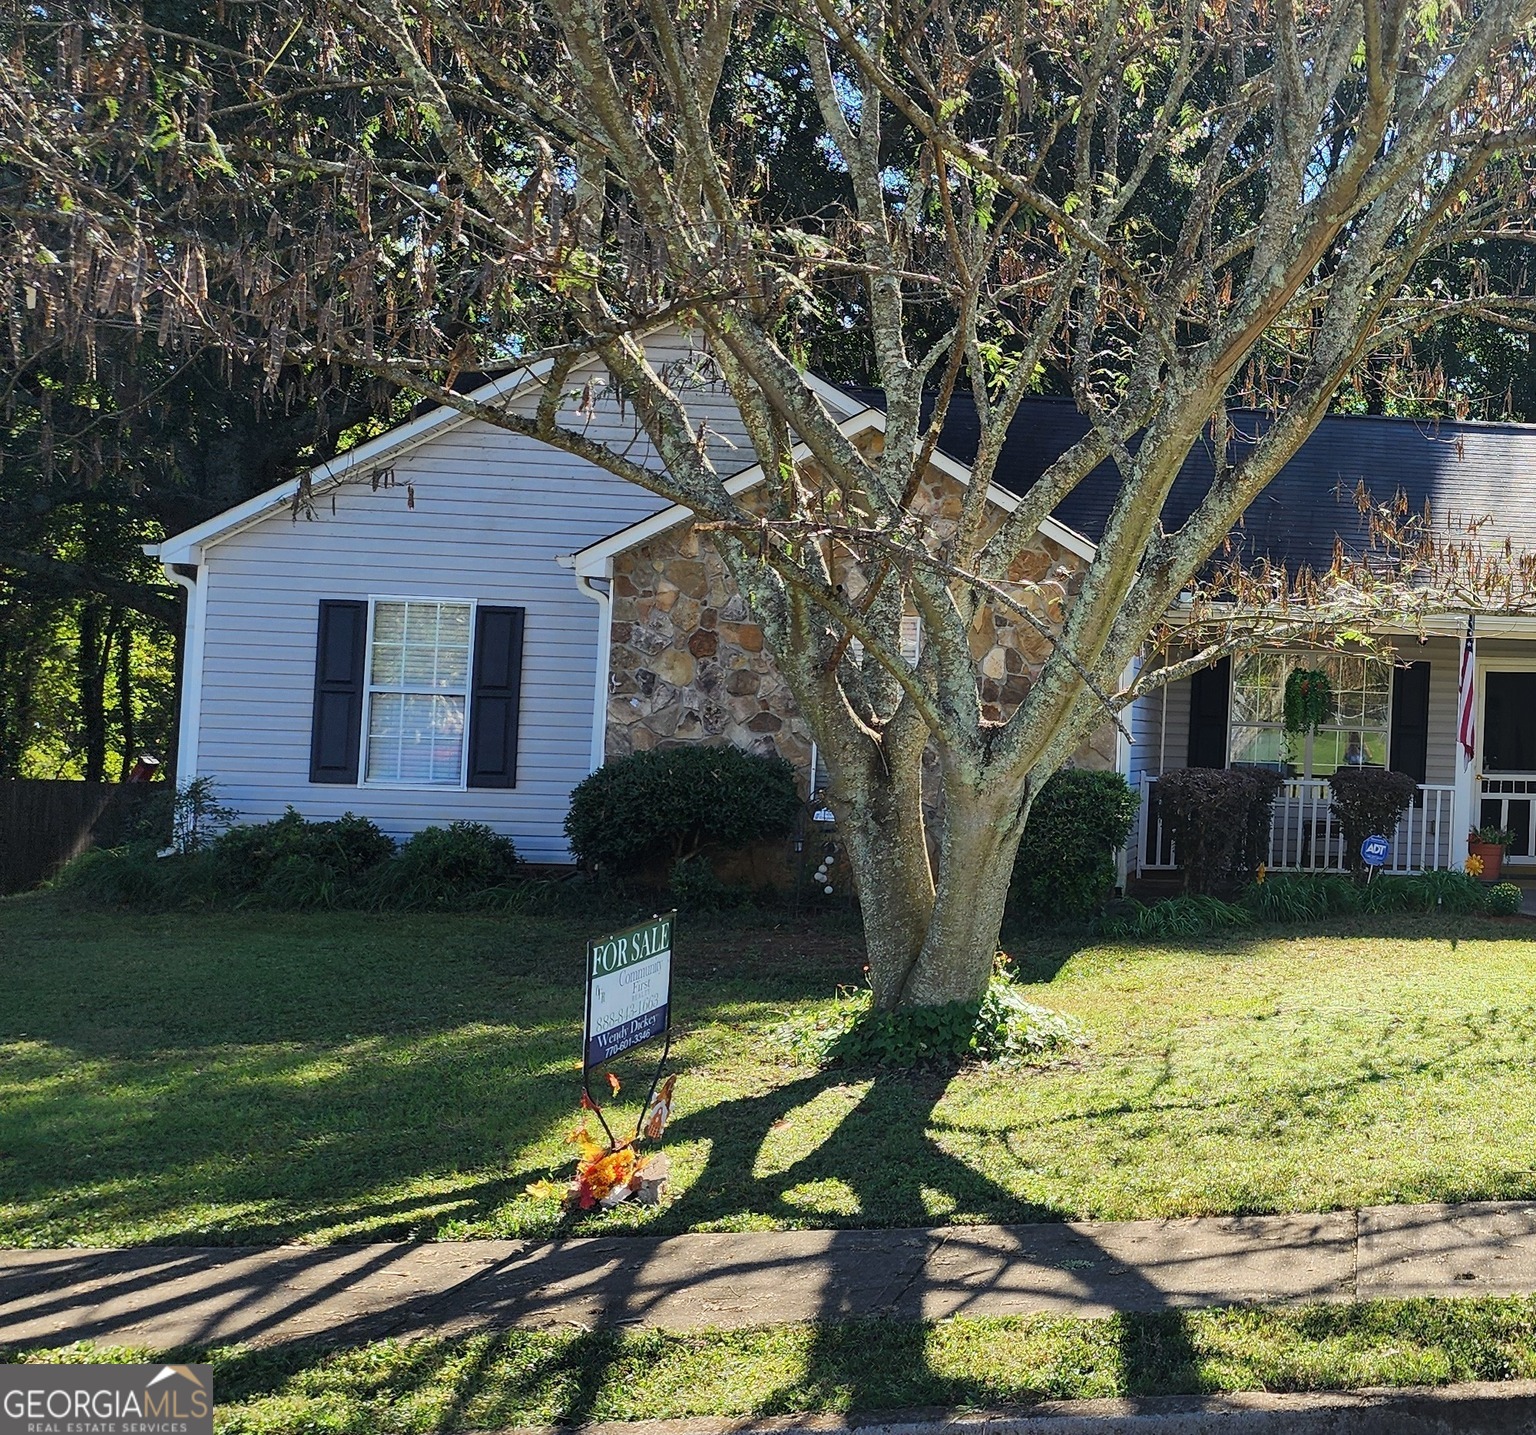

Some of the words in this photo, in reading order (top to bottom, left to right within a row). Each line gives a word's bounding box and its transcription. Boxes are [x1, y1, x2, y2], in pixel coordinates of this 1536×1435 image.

[1366, 843, 1387, 855] ADT
[592, 938, 628, 976] FOR
[631, 922, 670, 961] SALE
[619, 959, 664, 987] Community
[632, 979, 651, 994] First
[597, 1025, 629, 1048] Wendy
[630, 1013, 658, 1034] Dickey
